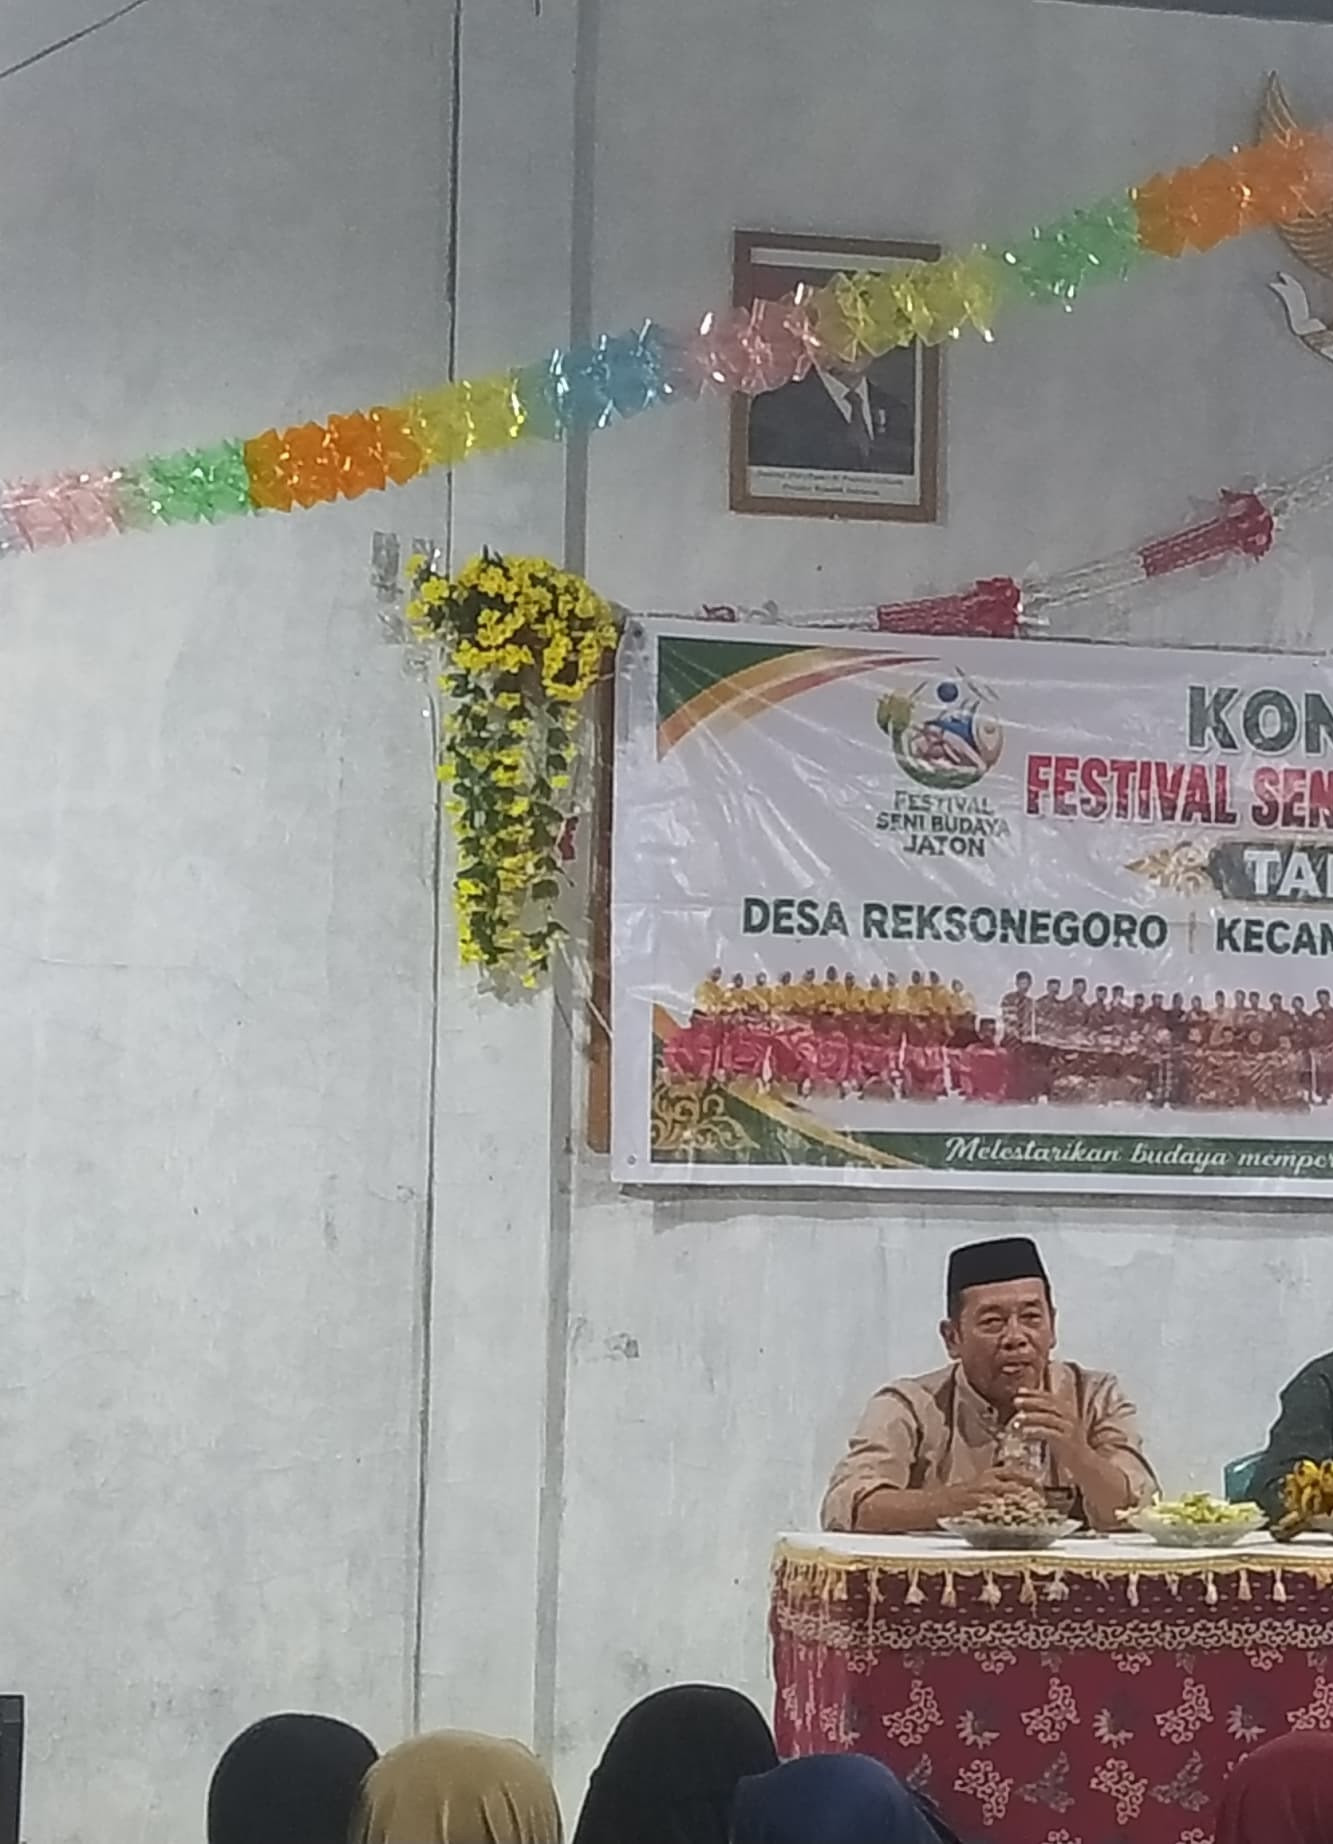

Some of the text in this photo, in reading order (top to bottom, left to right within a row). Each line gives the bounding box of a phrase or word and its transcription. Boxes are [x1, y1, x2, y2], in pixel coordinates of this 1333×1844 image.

[893, 790, 995, 816] FESTIVAL
[1025, 753, 1238, 825] FESTIVAL
[876, 811, 1011, 838] SENI BUDAYA
[903, 834, 986, 858] JATON
[742, 897, 850, 938] DESA
[862, 901, 1169, 949] REKSONEGORO
[945, 1136, 1121, 1163] Melestarikan
[1128, 1142, 1228, 1173] budaya
